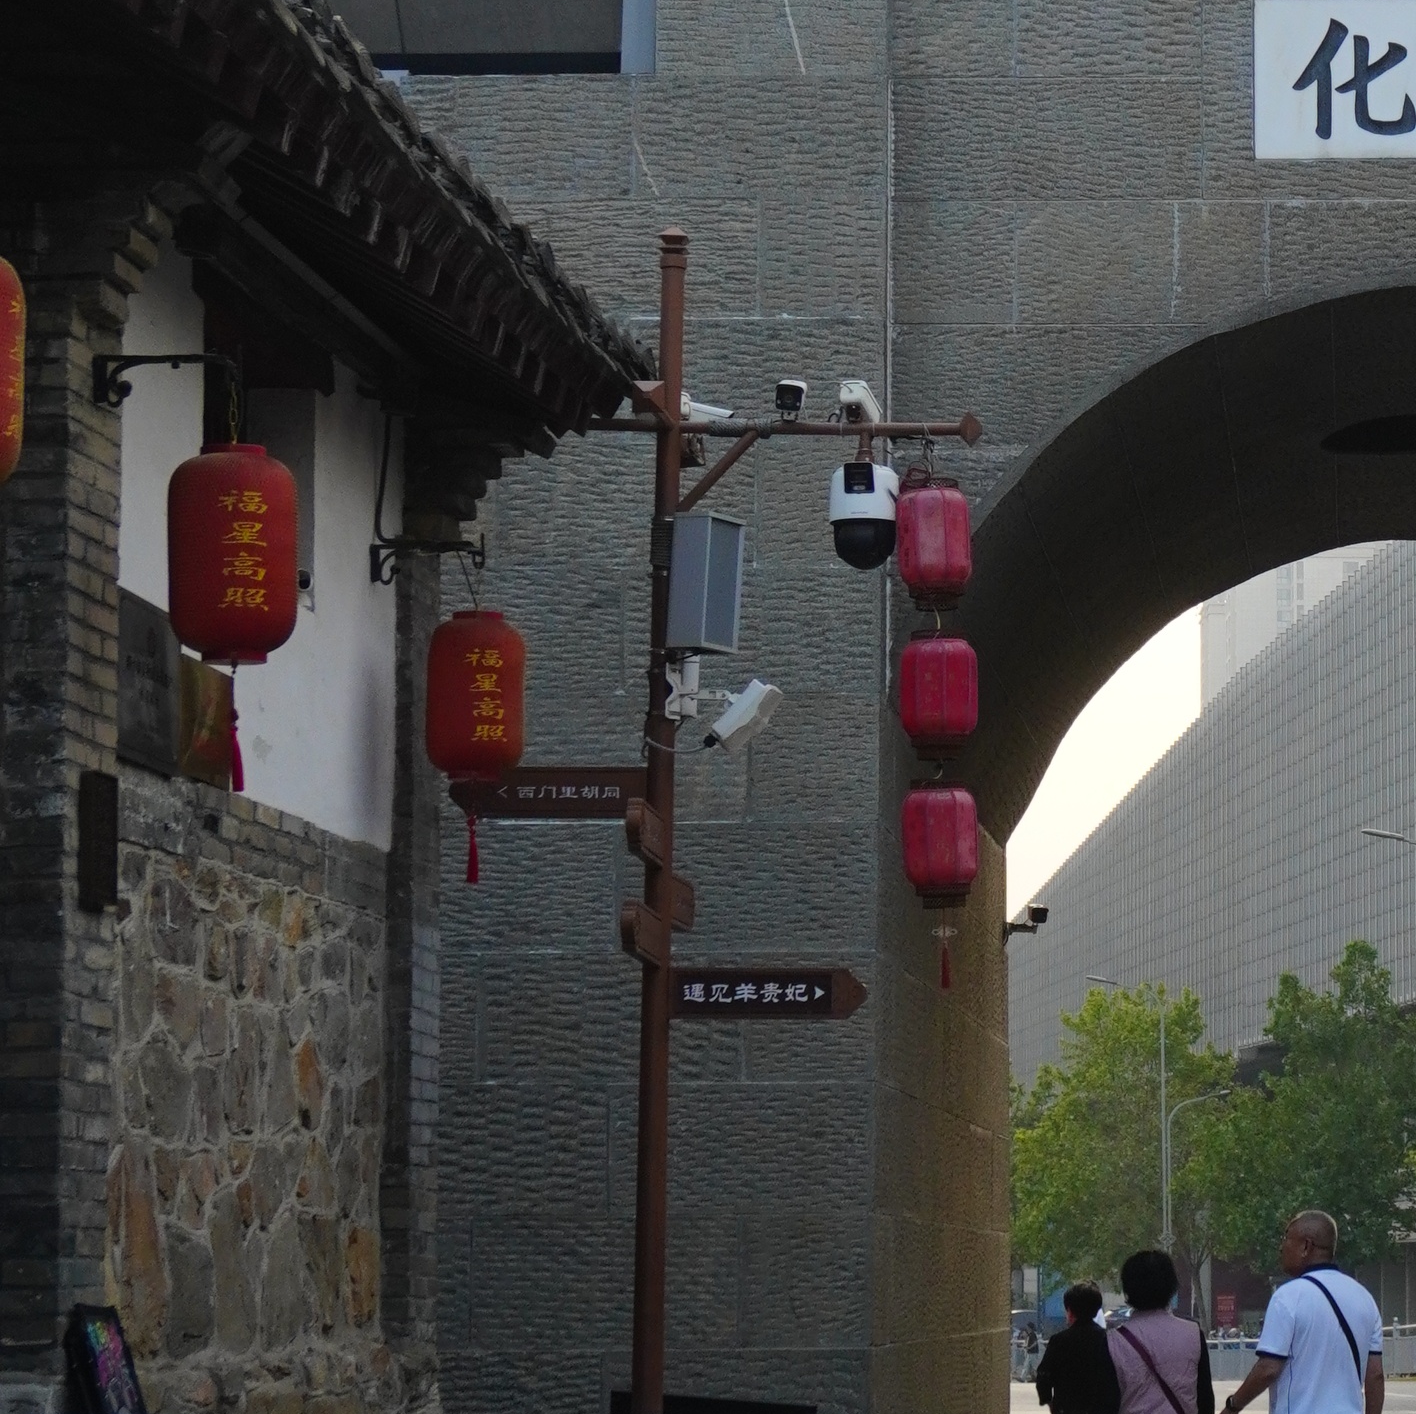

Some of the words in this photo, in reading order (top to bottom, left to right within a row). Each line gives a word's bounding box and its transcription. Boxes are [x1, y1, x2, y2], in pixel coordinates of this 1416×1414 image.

[217, 489, 269, 612] 福星高照
[464, 647, 508, 743] 福星高照
[516, 785, 621, 800] 西门里胡同
[682, 982, 809, 1004] 遇见羊贵妃
